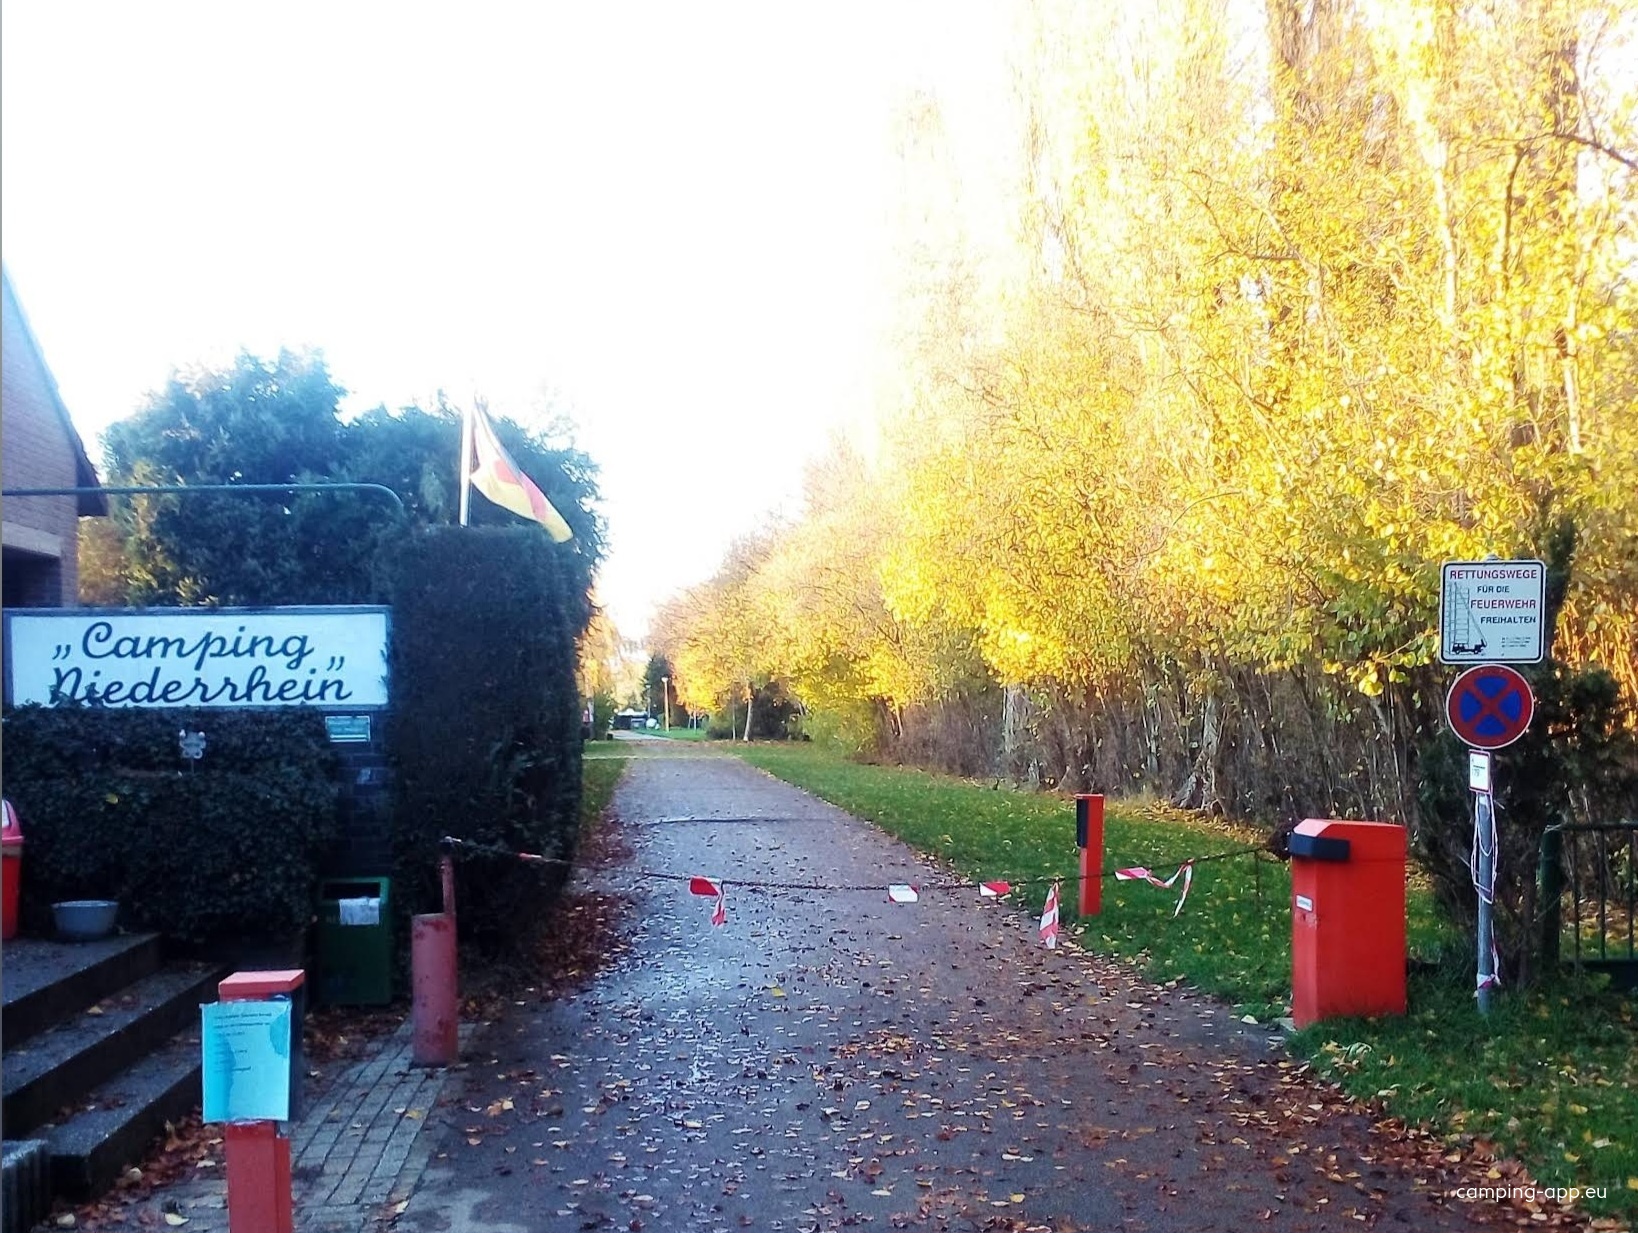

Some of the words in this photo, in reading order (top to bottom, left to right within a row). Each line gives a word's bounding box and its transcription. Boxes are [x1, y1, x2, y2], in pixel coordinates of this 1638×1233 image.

[1450, 569, 1537, 579] RETTUNGSWEGE
[1477, 585, 1494, 593] FÜR
[1496, 585, 1510, 593] DIE
[1470, 599, 1537, 609] FEUERWEHR
[1480, 616, 1537, 624] FREIHALTEN
